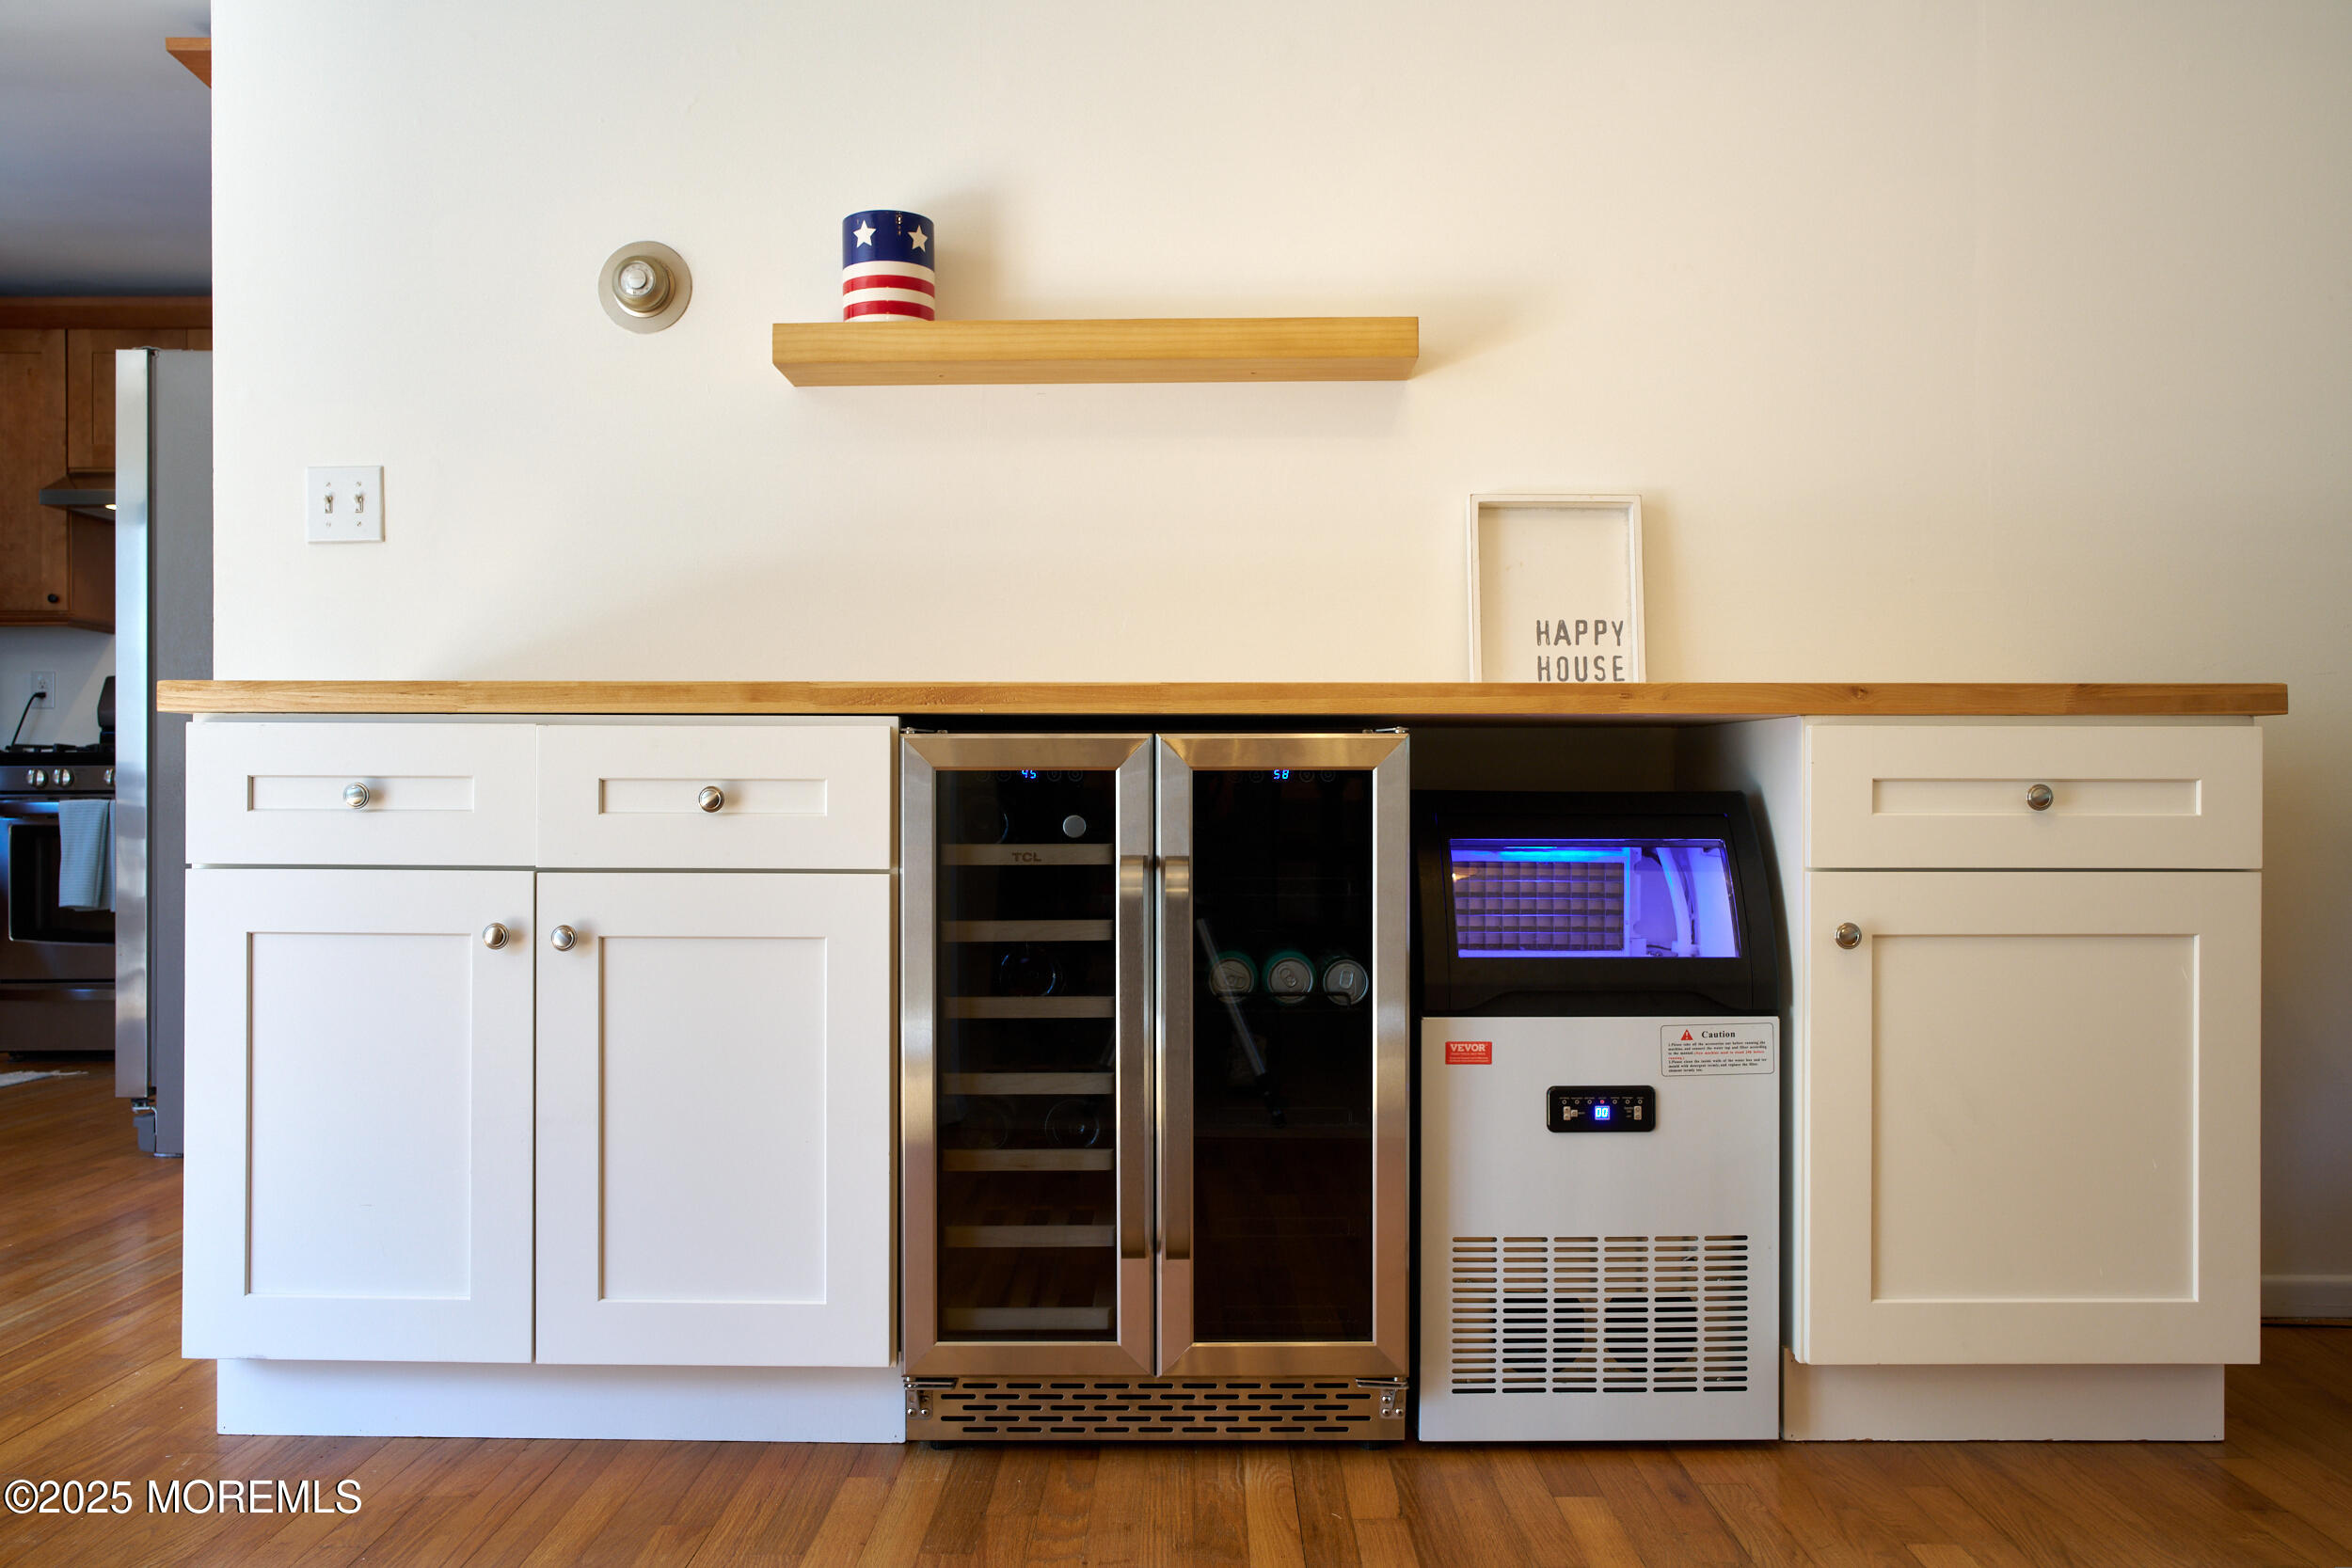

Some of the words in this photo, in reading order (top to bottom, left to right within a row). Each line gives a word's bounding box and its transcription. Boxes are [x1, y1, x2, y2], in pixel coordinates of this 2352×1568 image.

[1536, 619, 1624, 646] HAPPY
[1537, 656, 1626, 682] HOUSE
[1021, 769, 1037, 779] 45
[1273, 769, 1290, 780] 58
[1011, 851, 1041, 863] TCL
[1701, 1030, 1736, 1038] Caution
[1450, 1043, 1486, 1053] VEVOR
